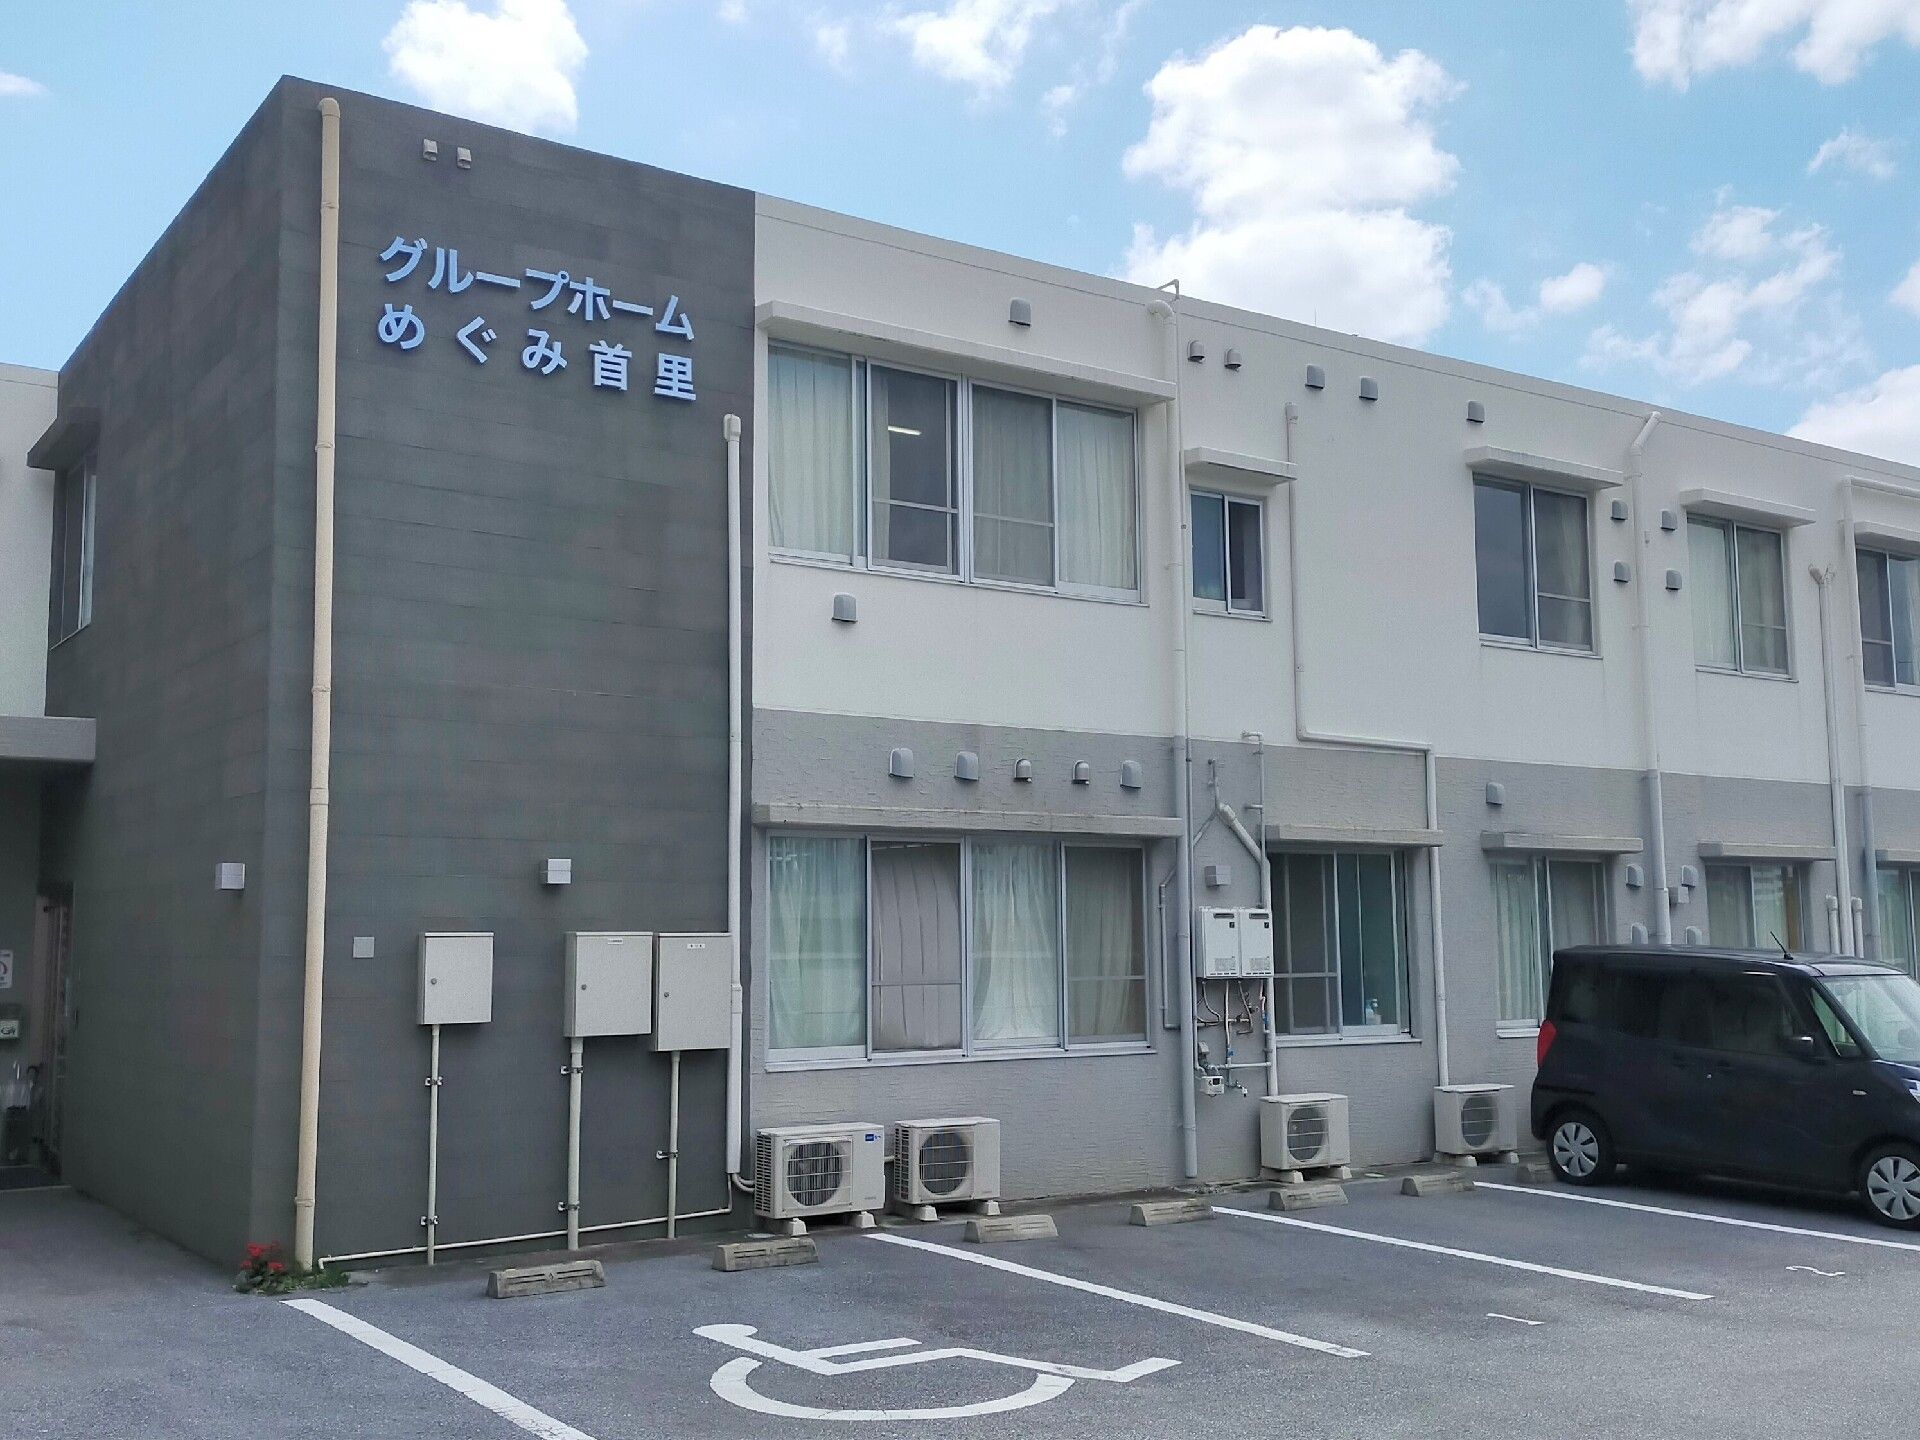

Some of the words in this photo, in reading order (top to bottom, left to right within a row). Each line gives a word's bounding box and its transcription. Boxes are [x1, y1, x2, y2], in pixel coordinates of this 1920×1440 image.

[379, 236, 695, 341] グループホーム
[378, 303, 697, 401] めぐみ首里
